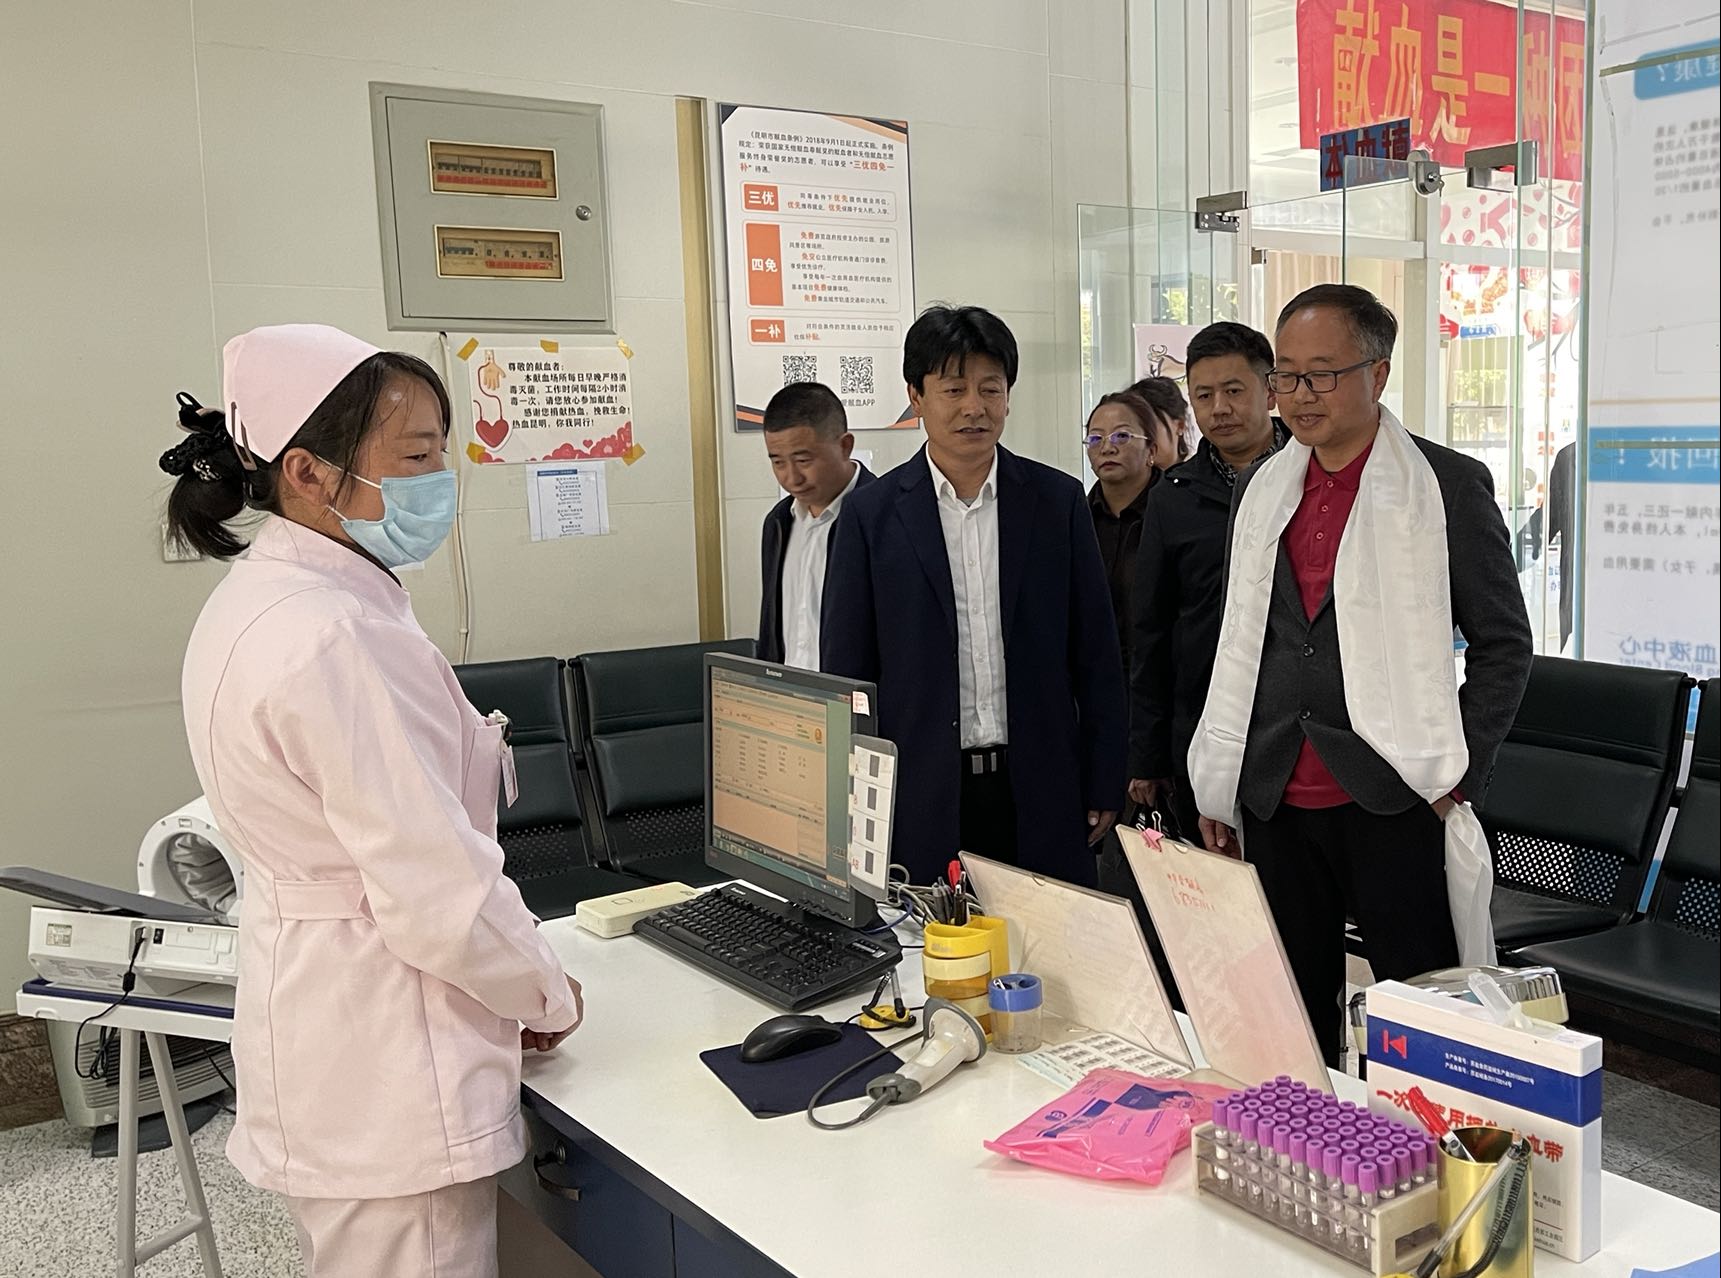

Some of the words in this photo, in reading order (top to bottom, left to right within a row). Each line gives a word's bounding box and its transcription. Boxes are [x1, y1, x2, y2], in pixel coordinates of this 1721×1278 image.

[748, 190, 775, 206] 三优
[751, 257, 778, 273] 四免
[754, 323, 781, 339] 一补
[508, 362, 564, 372] 尊敬的献血者：
[524, 373, 627, 383] 本献血场所每日早晚严格消
